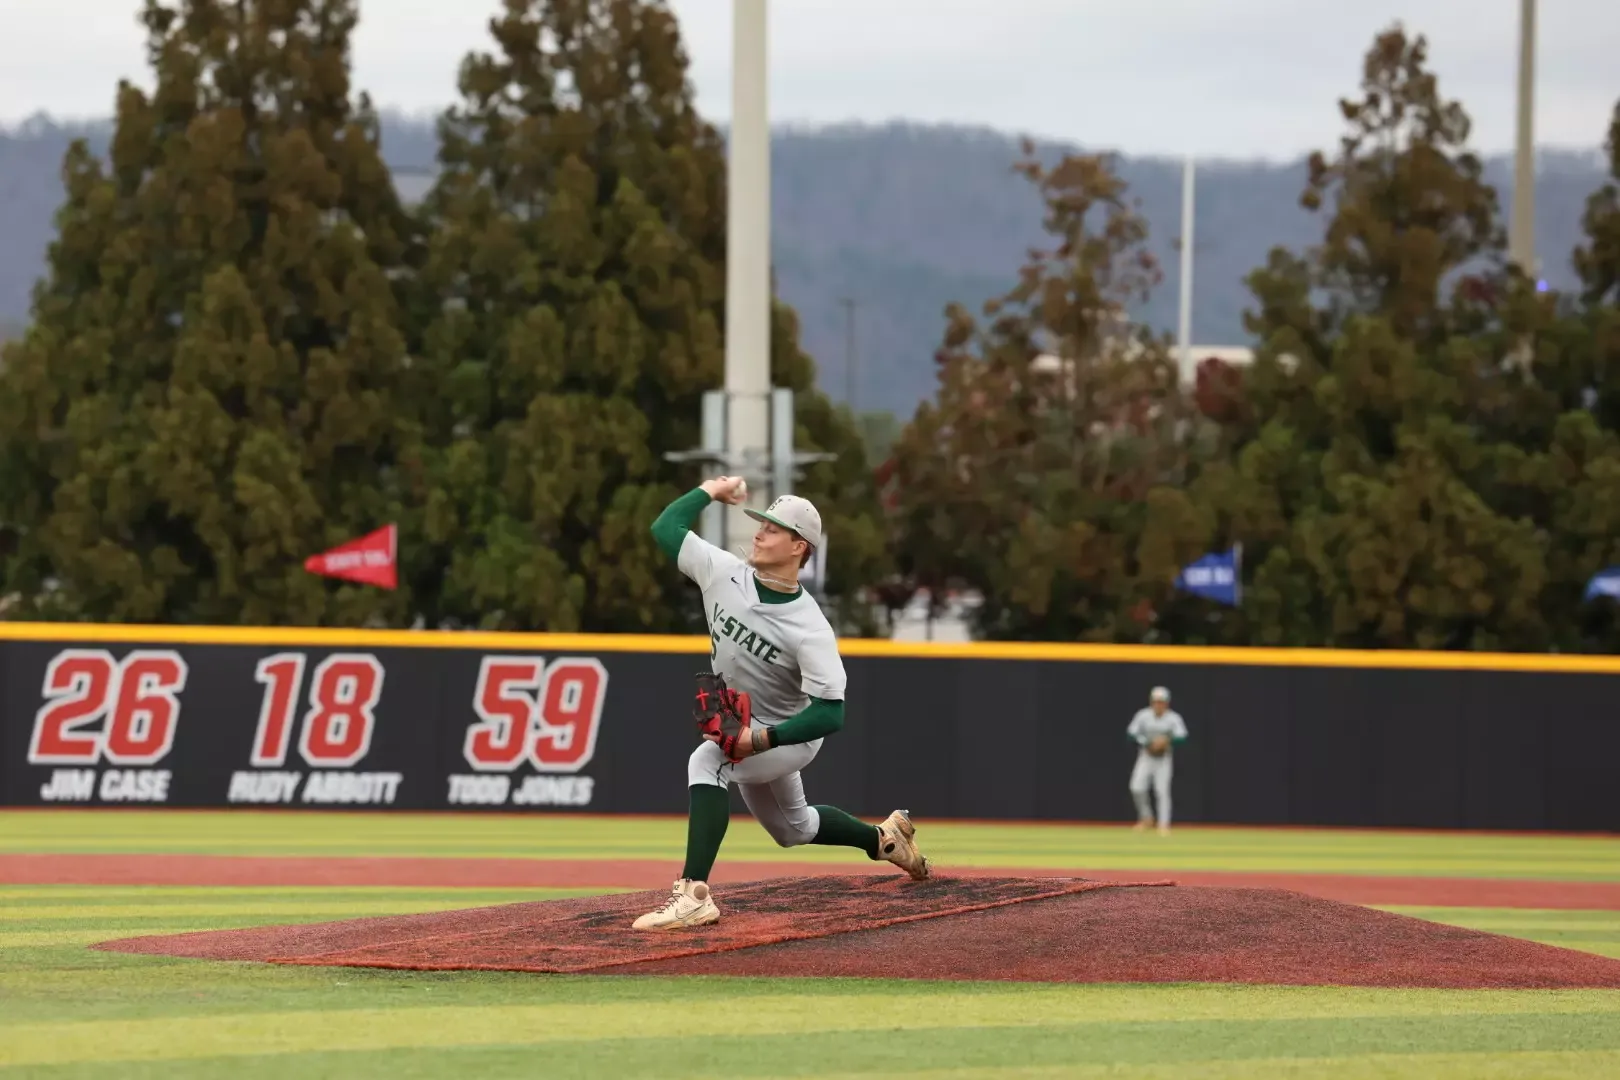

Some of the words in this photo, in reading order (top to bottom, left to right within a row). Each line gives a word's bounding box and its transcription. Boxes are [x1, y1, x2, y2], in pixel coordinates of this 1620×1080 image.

[27, 649, 189, 765] 26
[249, 652, 386, 767] 18
[463, 655, 609, 772] 59
[40, 769, 96, 801] JIM
[99, 769, 172, 801] CASE
[227, 771, 302, 803] RUDY
[301, 772, 404, 804] ABBOTT
[447, 774, 510, 805] TODD
[512, 776, 595, 806] JONES
